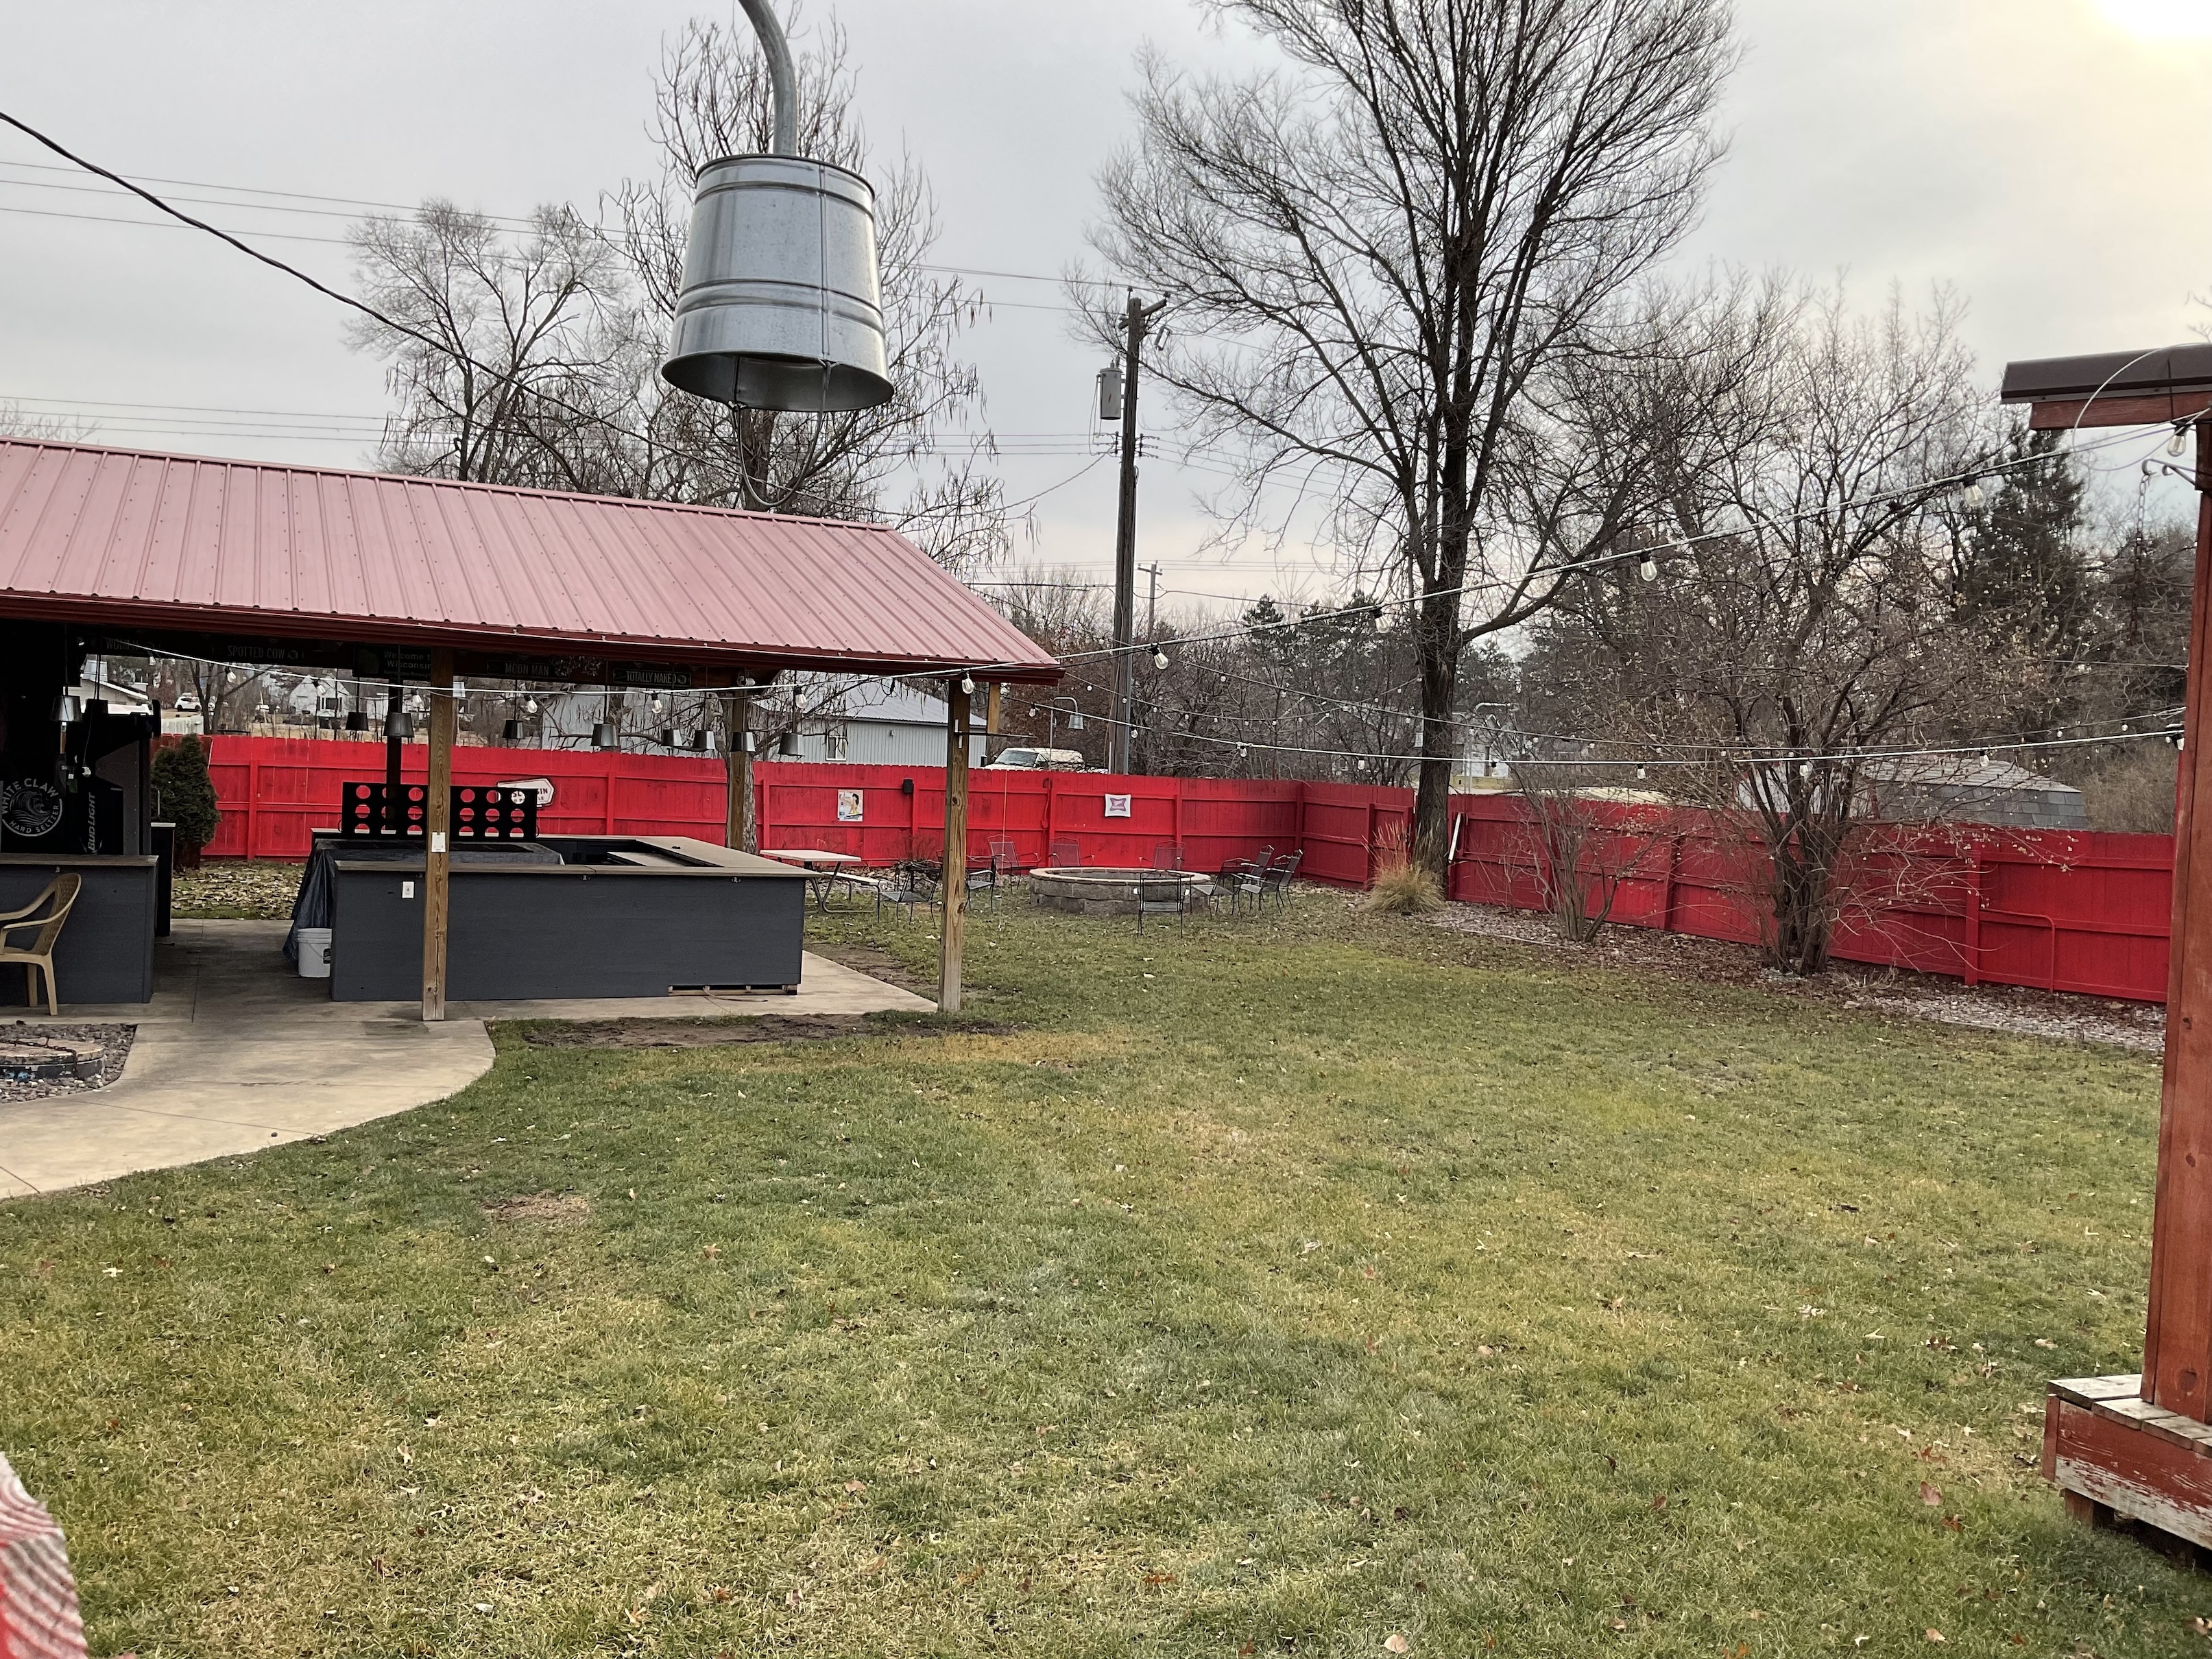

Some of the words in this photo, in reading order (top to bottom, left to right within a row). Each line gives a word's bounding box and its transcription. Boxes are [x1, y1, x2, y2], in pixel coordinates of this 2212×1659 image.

[228, 645, 263, 658] SPOTTED
[266, 647, 285, 659] COW
[384, 651, 424, 660] Wecome
[505, 663, 529, 675] MOON
[531, 664, 549, 676] MAN
[626, 671, 653, 682] TOTALLY
[653, 672, 676, 684] NAKED
[1, 780, 22, 815] WHITE
[23, 778, 59, 798] CLAW
[88, 791, 96, 826] LIGHT
[10, 821, 32, 833] HARD
[35, 804, 60, 833] SELTZER
[88, 826, 96, 851] BUD
